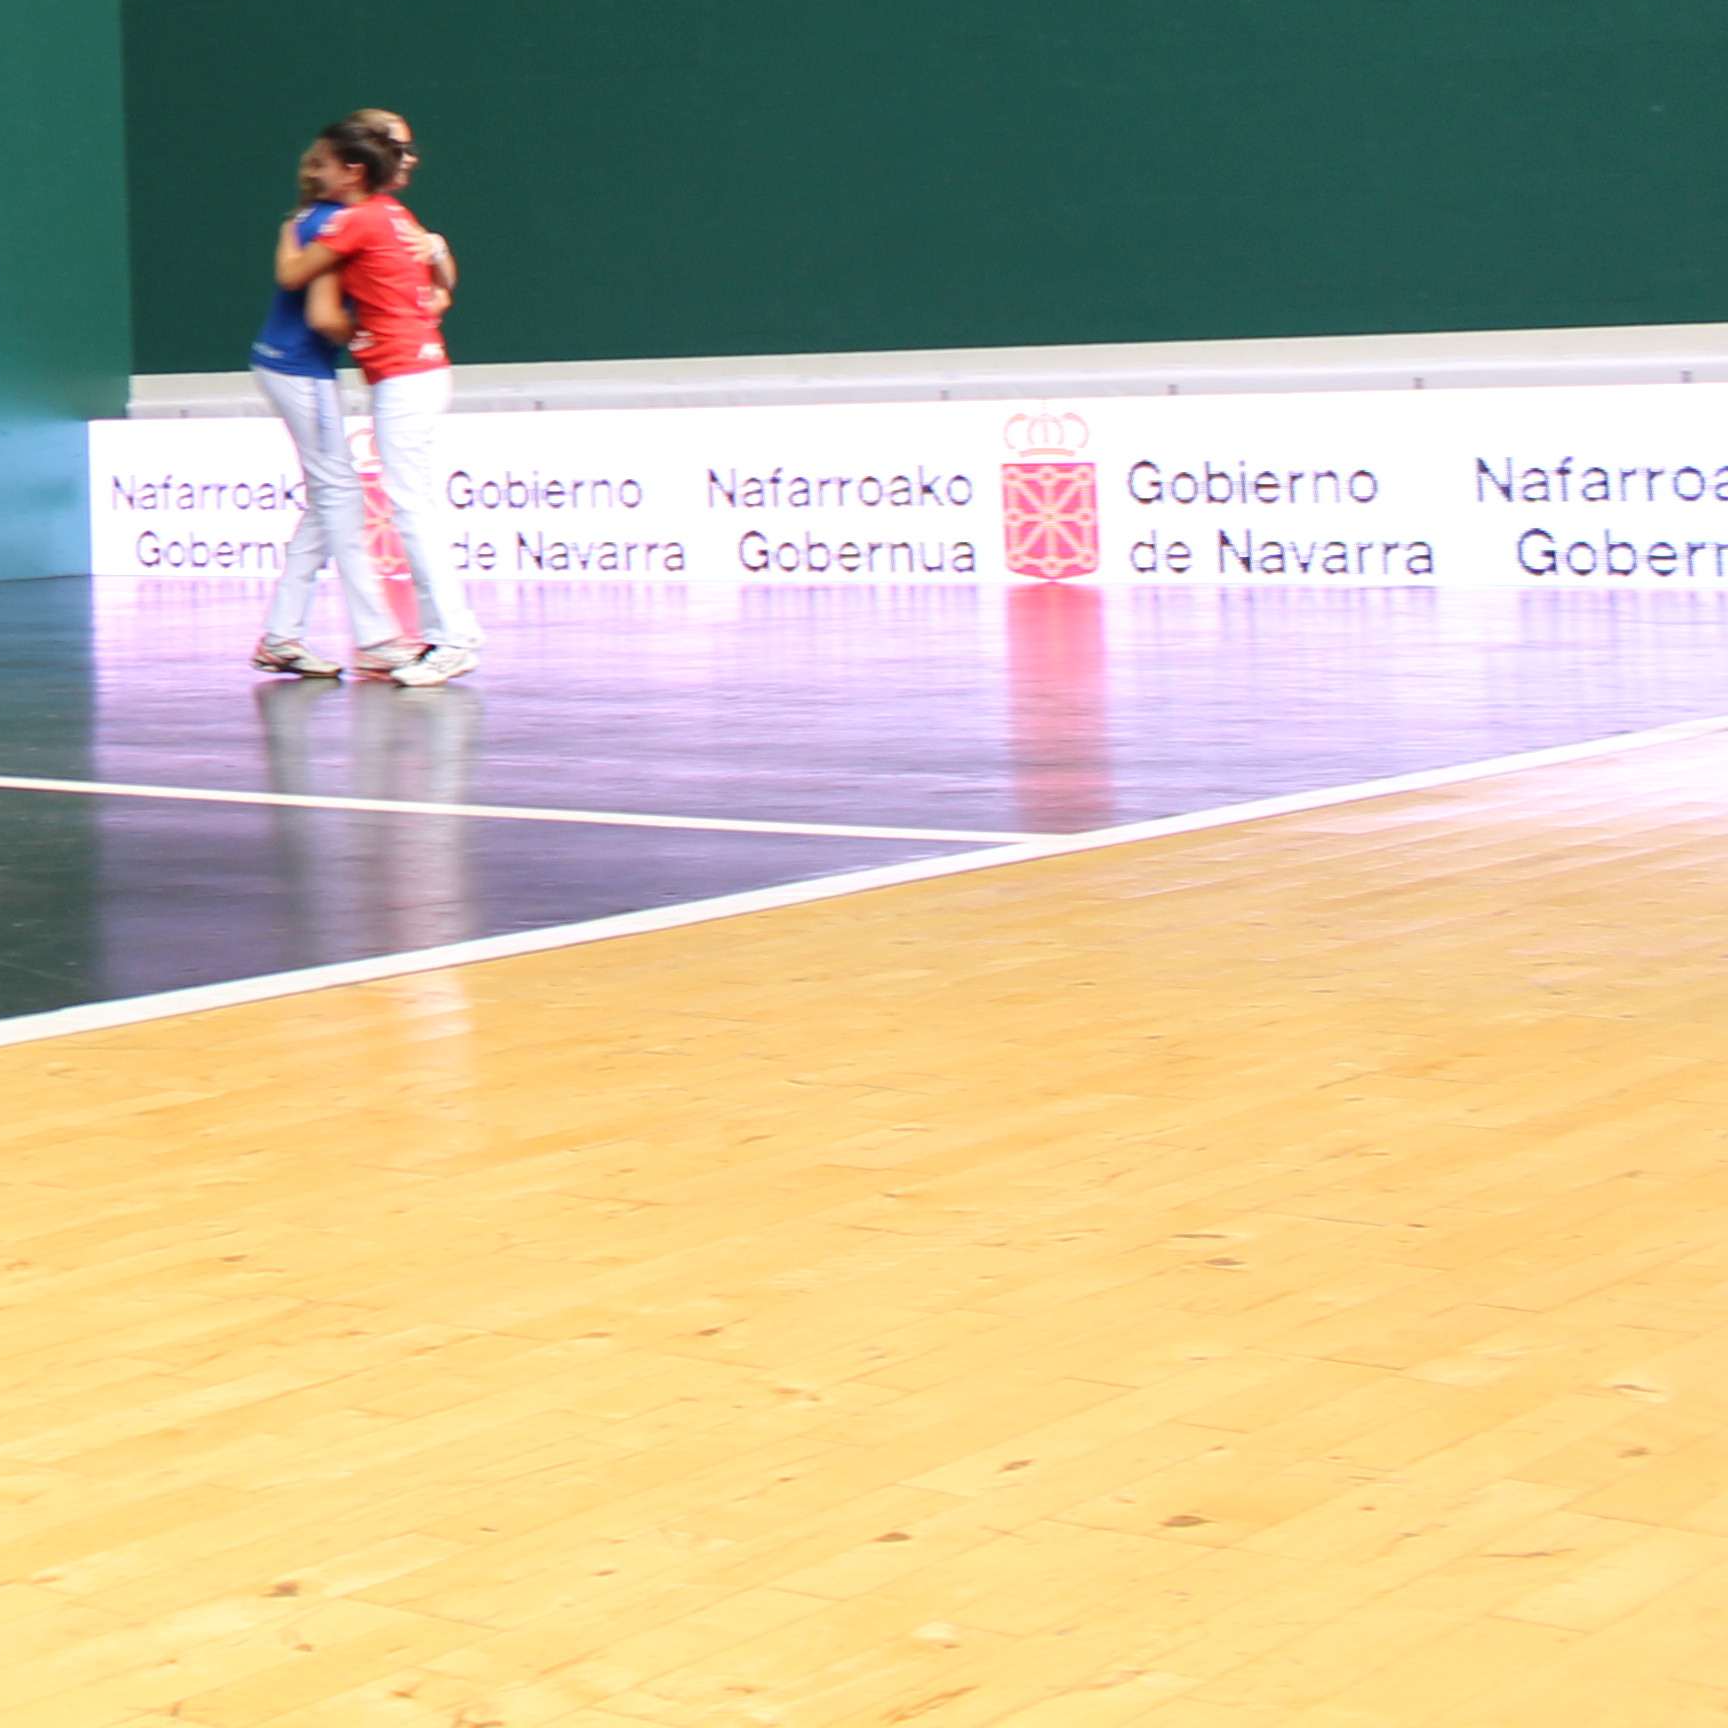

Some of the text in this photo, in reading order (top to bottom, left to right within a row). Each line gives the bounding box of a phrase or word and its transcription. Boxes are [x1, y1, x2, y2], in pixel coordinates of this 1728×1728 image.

[447, 470, 642, 509] Gobierno
[707, 464, 974, 508] Nafarroako
[1127, 459, 1381, 505] Gobierno
[448, 531, 686, 572] de Navarra
[737, 530, 978, 574] Gobernua
[1128, 527, 1437, 576] de Navarra
